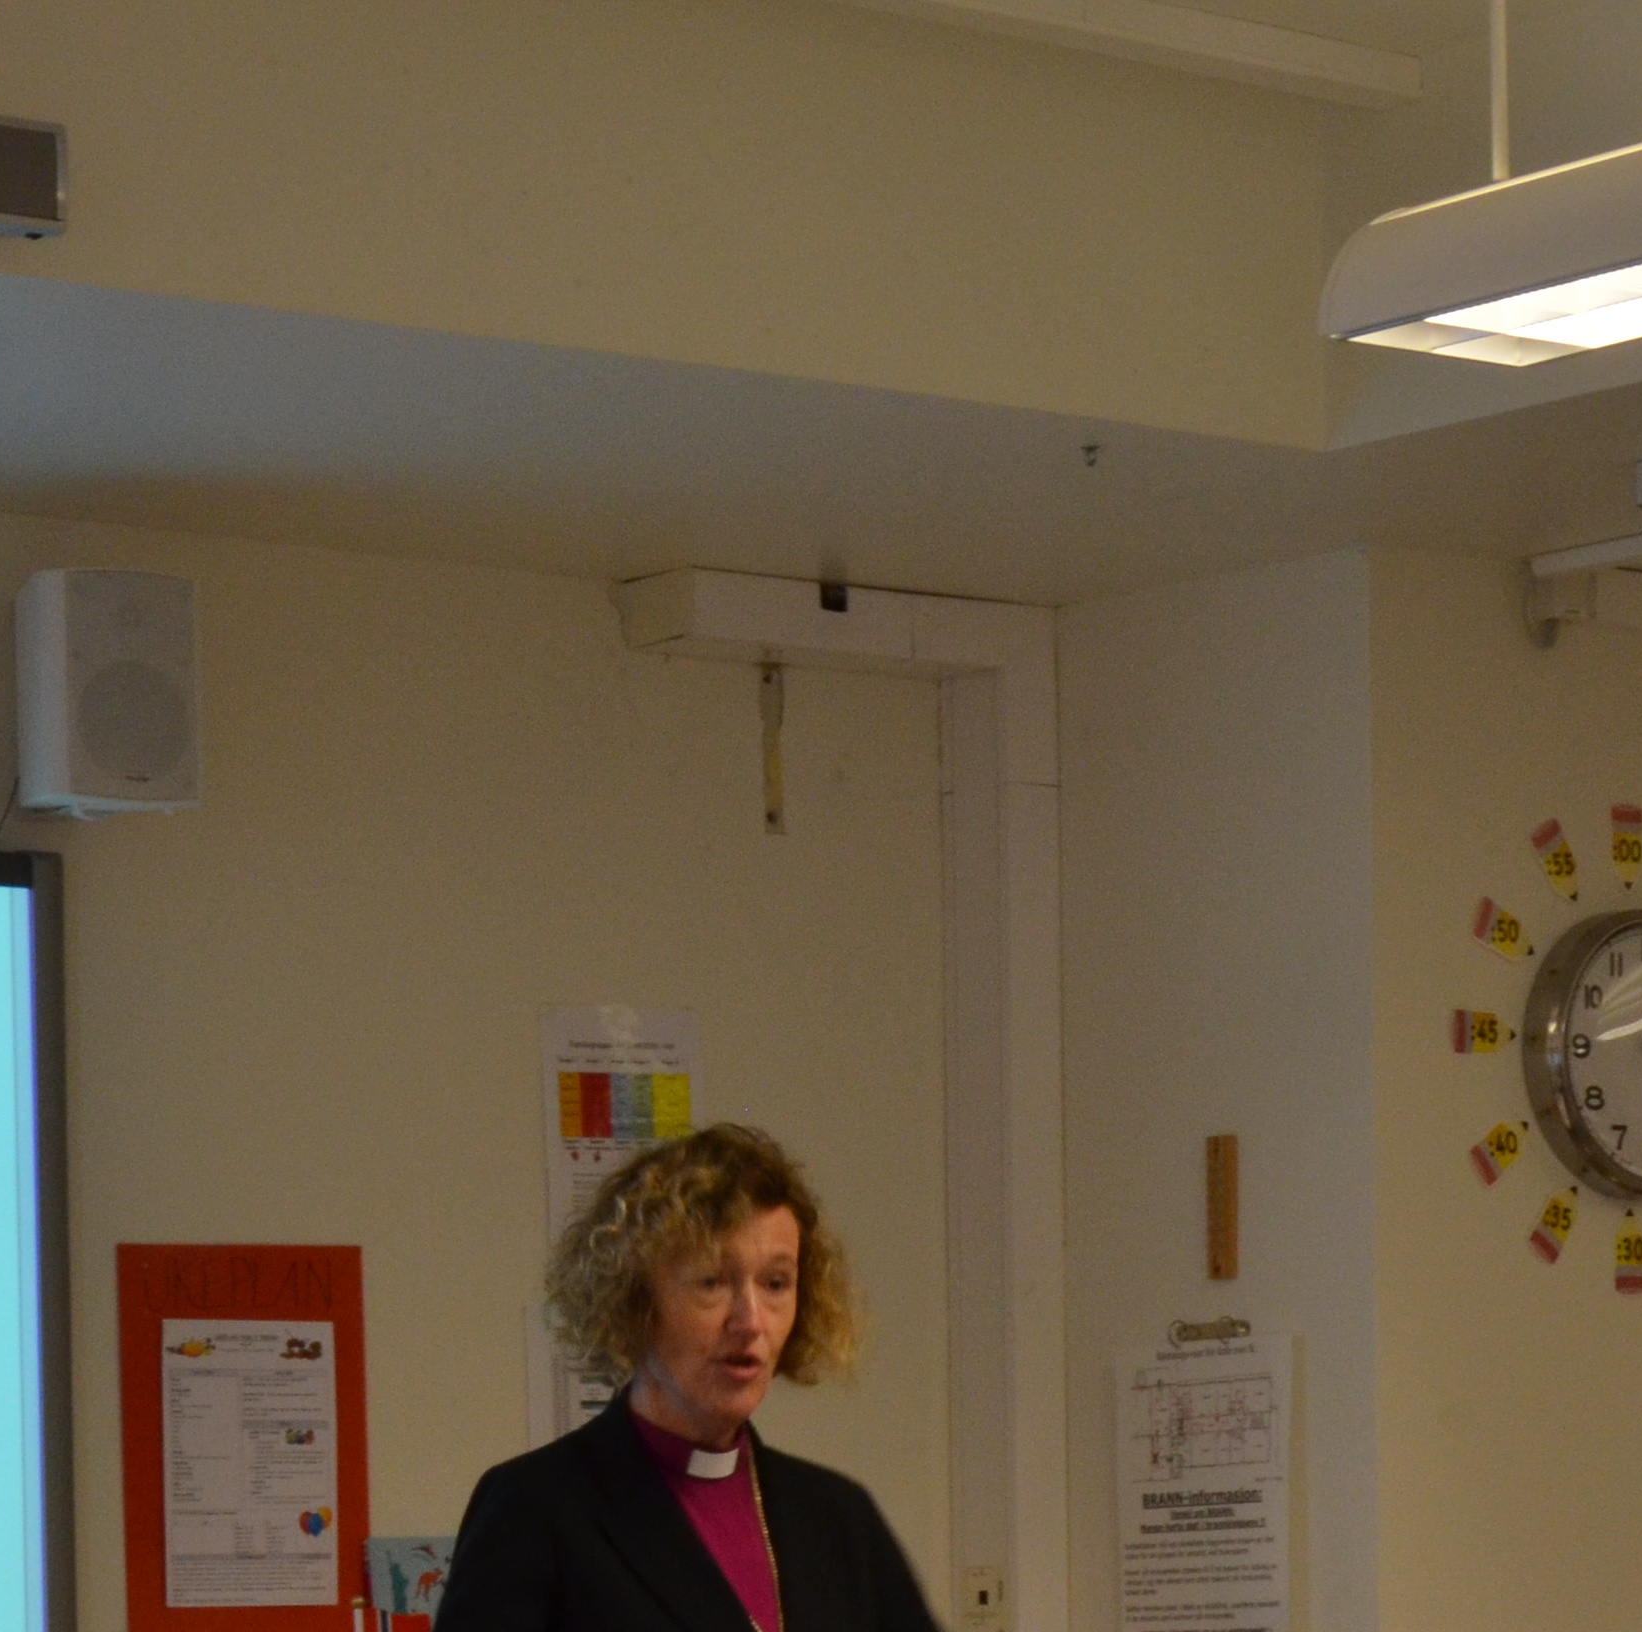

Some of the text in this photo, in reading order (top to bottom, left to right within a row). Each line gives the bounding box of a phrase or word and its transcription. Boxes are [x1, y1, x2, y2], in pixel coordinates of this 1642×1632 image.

[1609, 951, 1624, 976] 11
[1584, 984, 1603, 1010] 10
[1572, 1036, 1591, 1059] 9
[1585, 1086, 1605, 1111] 8
[1611, 1125, 1629, 1151] 7
